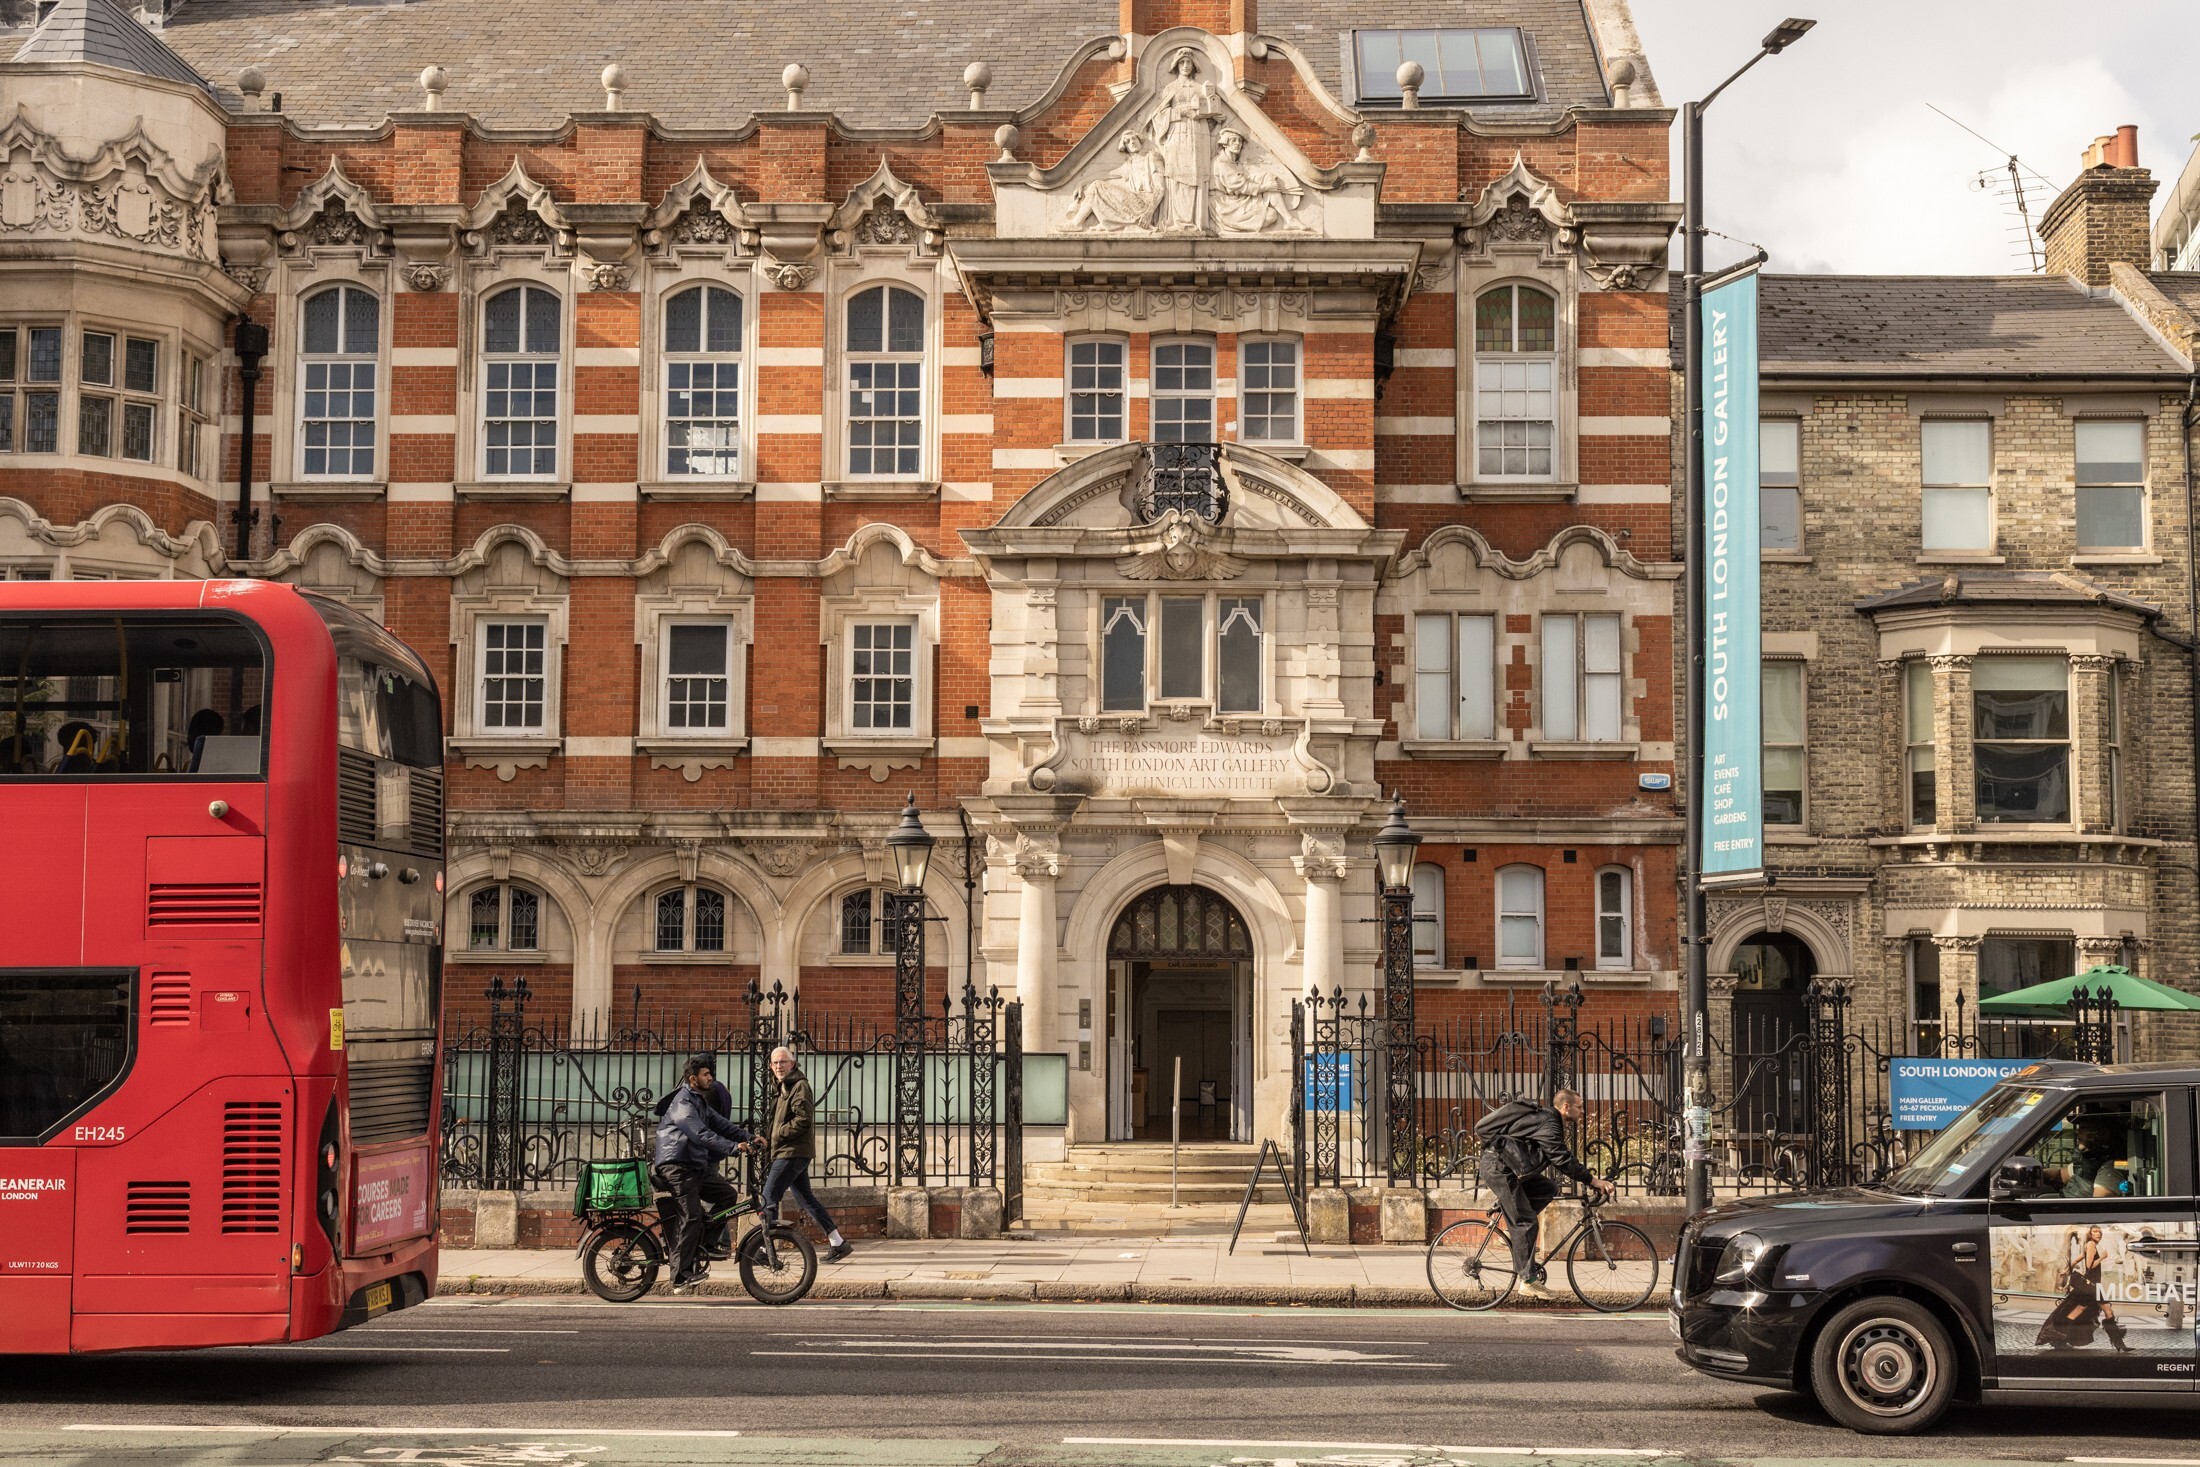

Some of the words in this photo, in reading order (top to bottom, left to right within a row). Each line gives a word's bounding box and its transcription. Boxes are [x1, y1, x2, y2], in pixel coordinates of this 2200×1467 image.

[1712, 309, 1728, 446] GALLERY
[1713, 457, 1728, 600] LONDON
[1713, 611, 1728, 722] SOUTH
[1090, 741, 1120, 753] THE
[1123, 741, 1197, 754] PASSMORE
[1201, 741, 1273, 754] EDWARDS
[1071, 758, 1119, 771] SOUTH
[1124, 758, 1185, 771] LONDON
[1189, 758, 1219, 771] ART
[1222, 758, 1290, 772] GALLERY
[1714, 754, 1726, 765] ART
[1714, 767, 1739, 780] EVENTS
[1120, 776, 1197, 789] TECHNICAL
[1202, 776, 1278, 790] INSTITUTE
[1714, 781, 1732, 795] CAFÉ
[1714, 798, 1734, 810] SHOP
[1714, 812, 1747, 825] GARDENS
[1714, 840, 1730, 851] FREE
[1731, 838, 1754, 850] ENTRY
[1899, 1066, 1940, 1077] SOUTH
[1943, 1066, 1997, 1078] LONDON
[75, 1126, 125, 1141] EH245
[1, 1192, 38, 1200] LONDON
[358, 1180, 389, 1204] COURSES
[390, 1176, 409, 1197] MADE
[371, 1198, 402, 1224] CAREERS
[725, 1204, 751, 1218] ALLEGRO
[2096, 1283, 2196, 1303] MICHAE
[2157, 1364, 2196, 1372] REGENT
